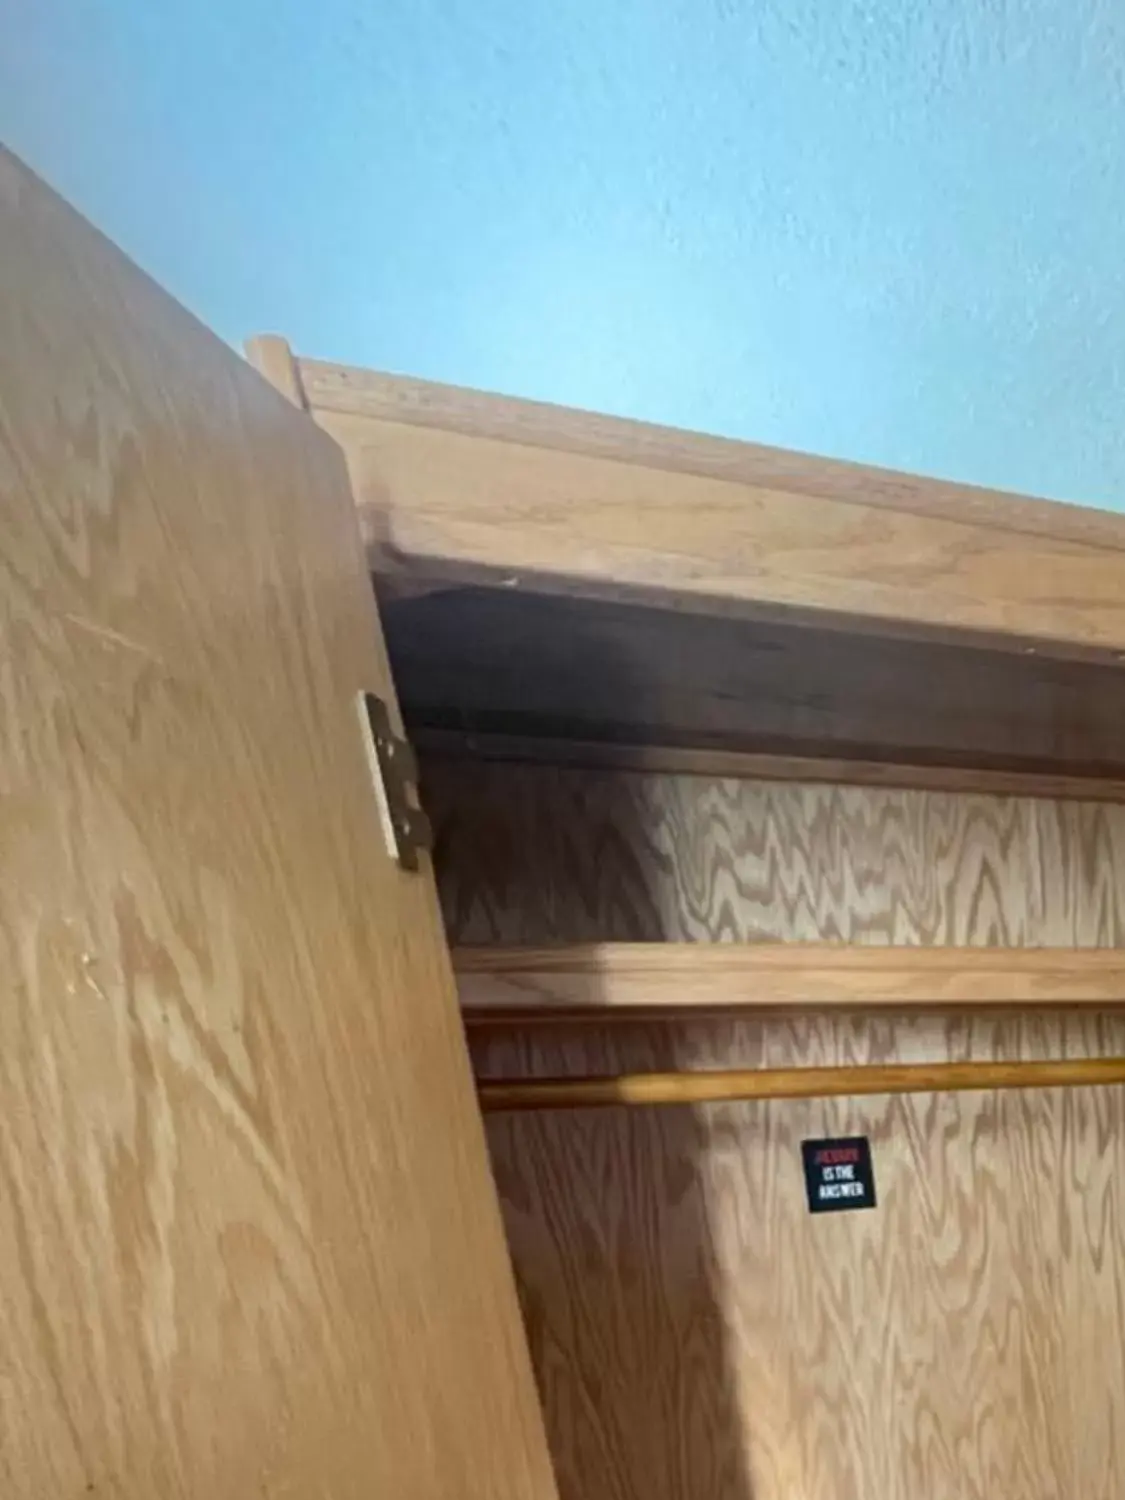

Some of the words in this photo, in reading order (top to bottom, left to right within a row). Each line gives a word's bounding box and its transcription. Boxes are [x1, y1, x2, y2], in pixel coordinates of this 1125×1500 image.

[822, 1166, 835, 1181] IS
[835, 1164, 855, 1180] THE
[819, 1181, 865, 1200] ANSWER
